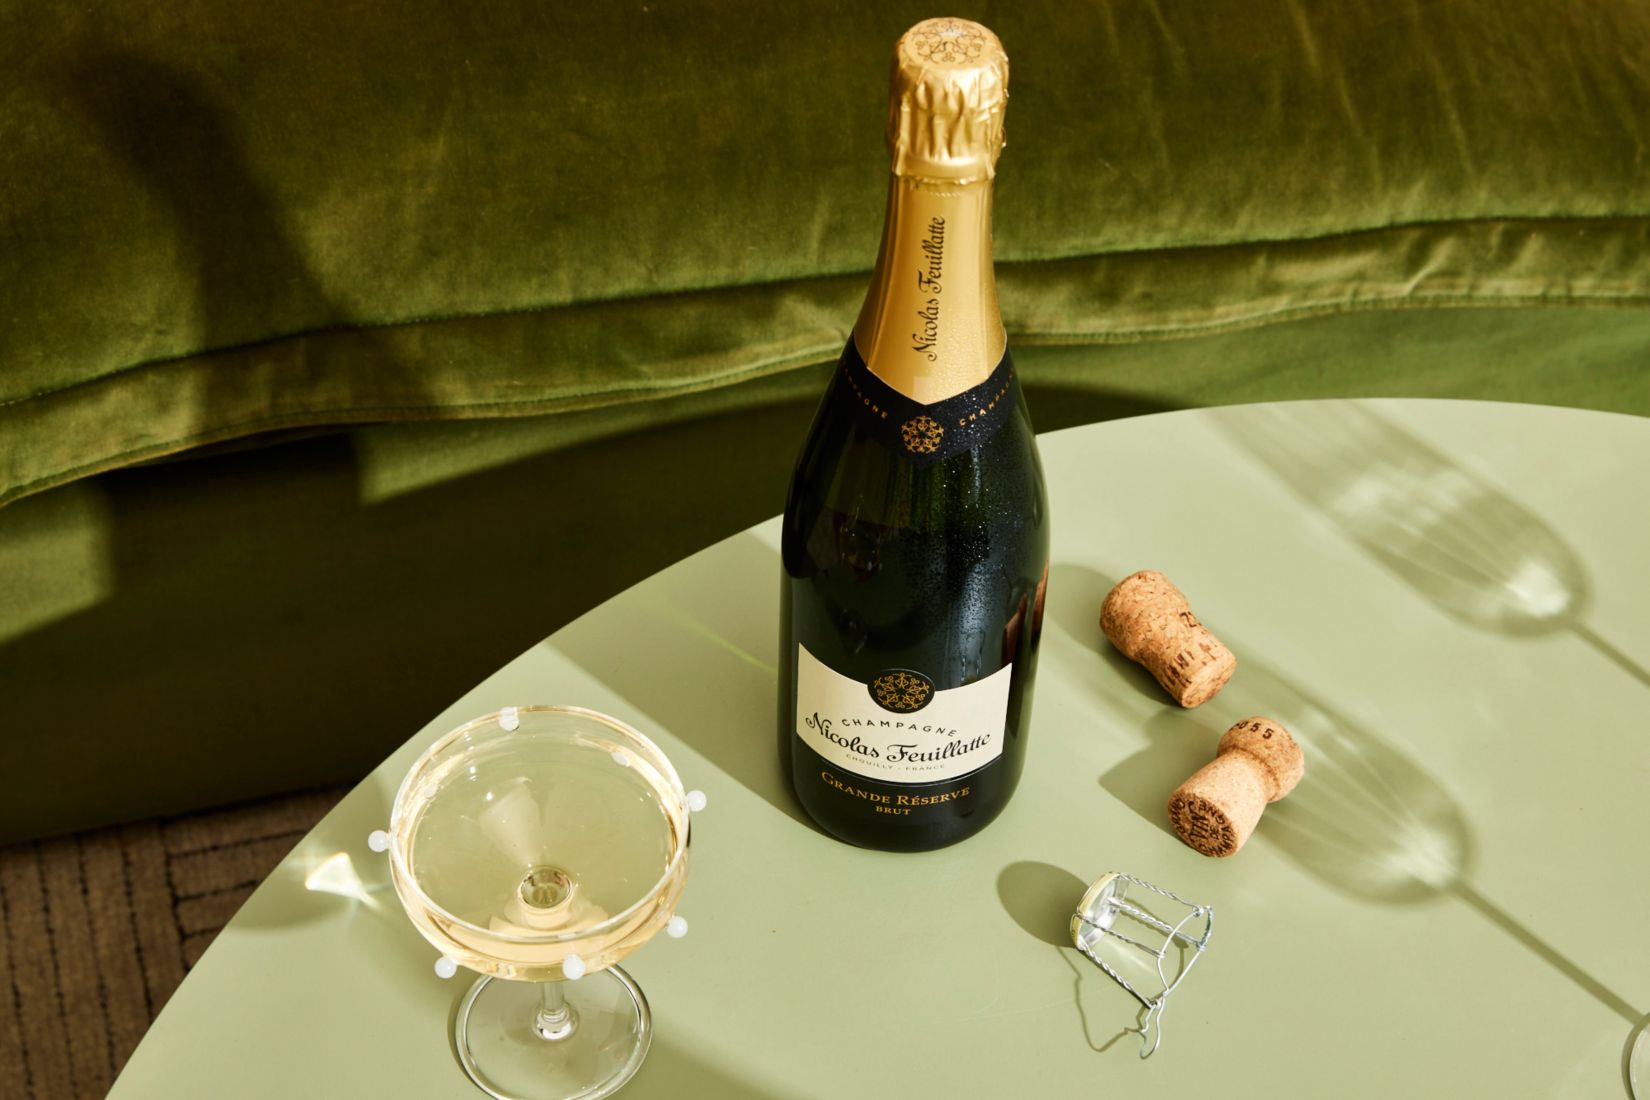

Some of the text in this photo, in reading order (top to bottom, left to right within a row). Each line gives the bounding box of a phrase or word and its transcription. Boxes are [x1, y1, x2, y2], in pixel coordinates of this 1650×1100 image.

[912, 216, 946, 362] Nicolas Feuillatte
[805, 712, 991, 763] Nicolas Feuillatte
[842, 718, 957, 737] CHAMPAGNE
[846, 754, 892, 769] CHOUILLY
[821, 771, 970, 805] GRANDE RÉSERVE
[876, 805, 911, 816] BRUT
